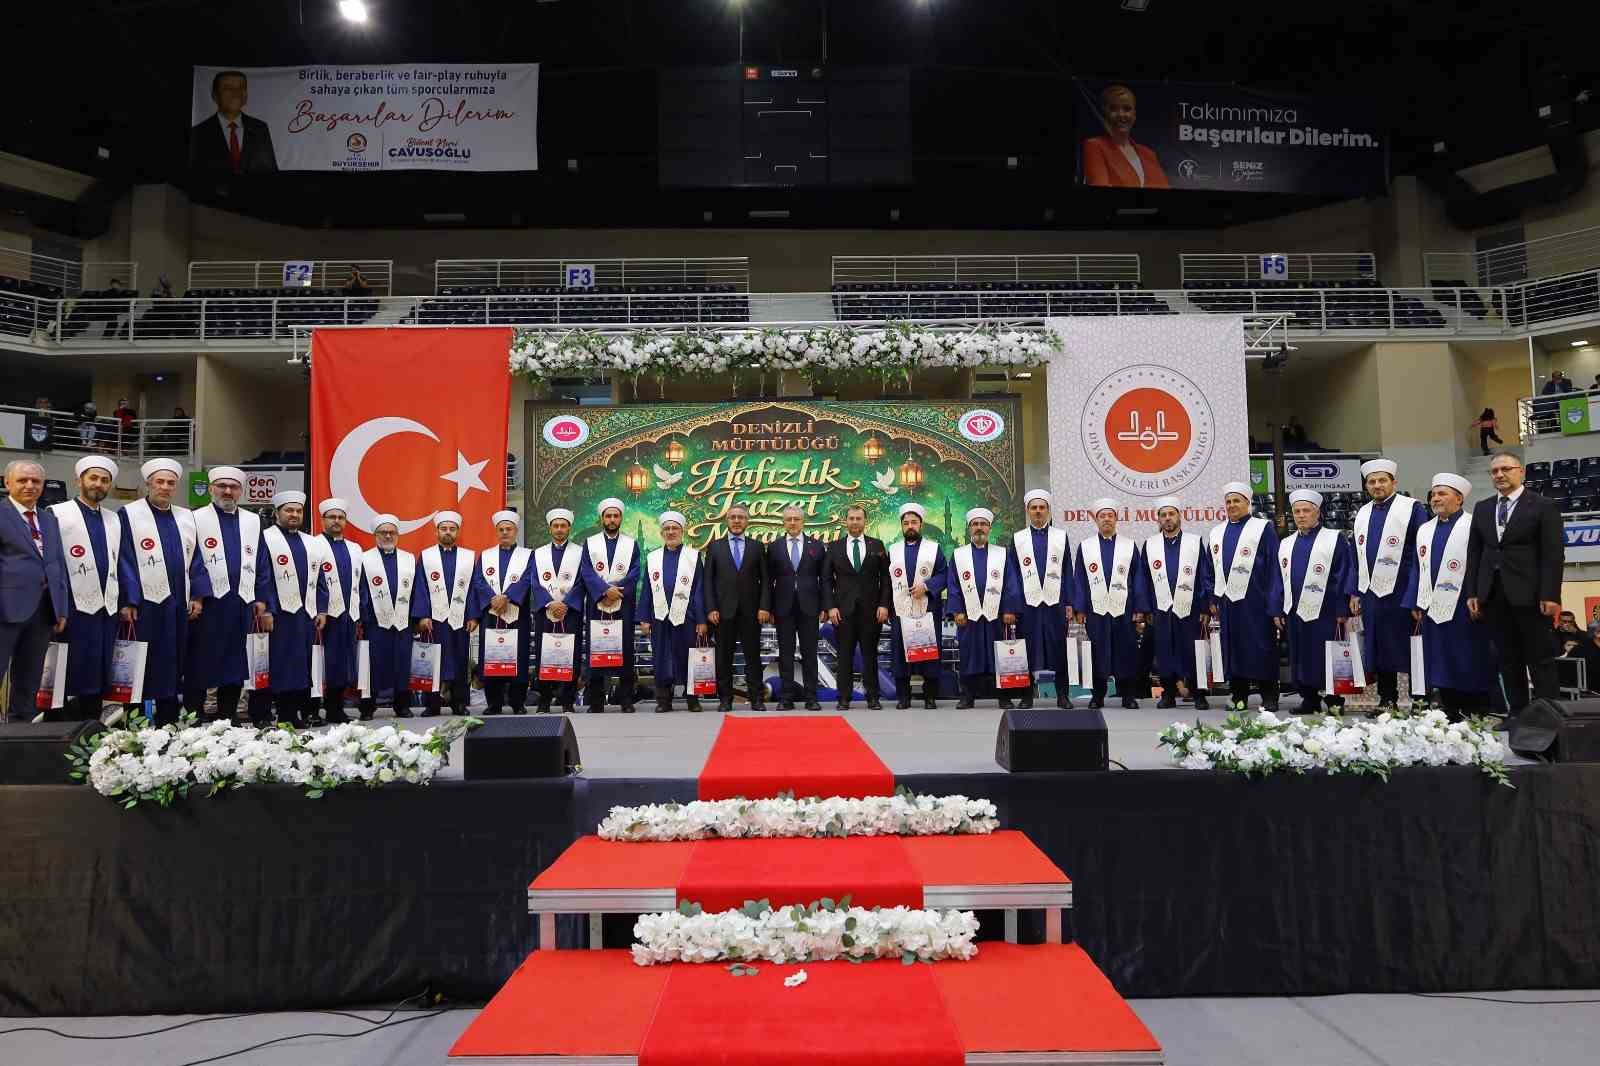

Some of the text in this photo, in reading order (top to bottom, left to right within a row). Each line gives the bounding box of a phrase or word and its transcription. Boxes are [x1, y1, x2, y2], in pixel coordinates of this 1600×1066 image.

[298, 70, 333, 81] Birlik,
[336, 70, 394, 81] beraberlik
[413, 70, 461, 82] fair-play
[464, 70, 507, 82] ruhuyla
[310, 84, 496, 96] sahaya çıkan tüm sporcularımıza
[418, 98, 513, 132] Dilerim
[1177, 101, 1297, 124] Takımımıza
[1178, 124, 1379, 148] Başarılar Dilerim.
[285, 264, 309, 281] F2
[1263, 257, 1285, 274] F5
[569, 269, 591, 285] F3
[732, 419, 816, 435] DENİZLİ
[711, 434, 840, 451] MÜFTÜLÜĞÜ
[1088, 431, 1121, 478] DİYANET
[249, 476, 274, 487] den
[687, 454, 861, 496] Hafızlık
[1063, 506, 1130, 522] DENLİ
[1565, 529, 1600, 544] yu
